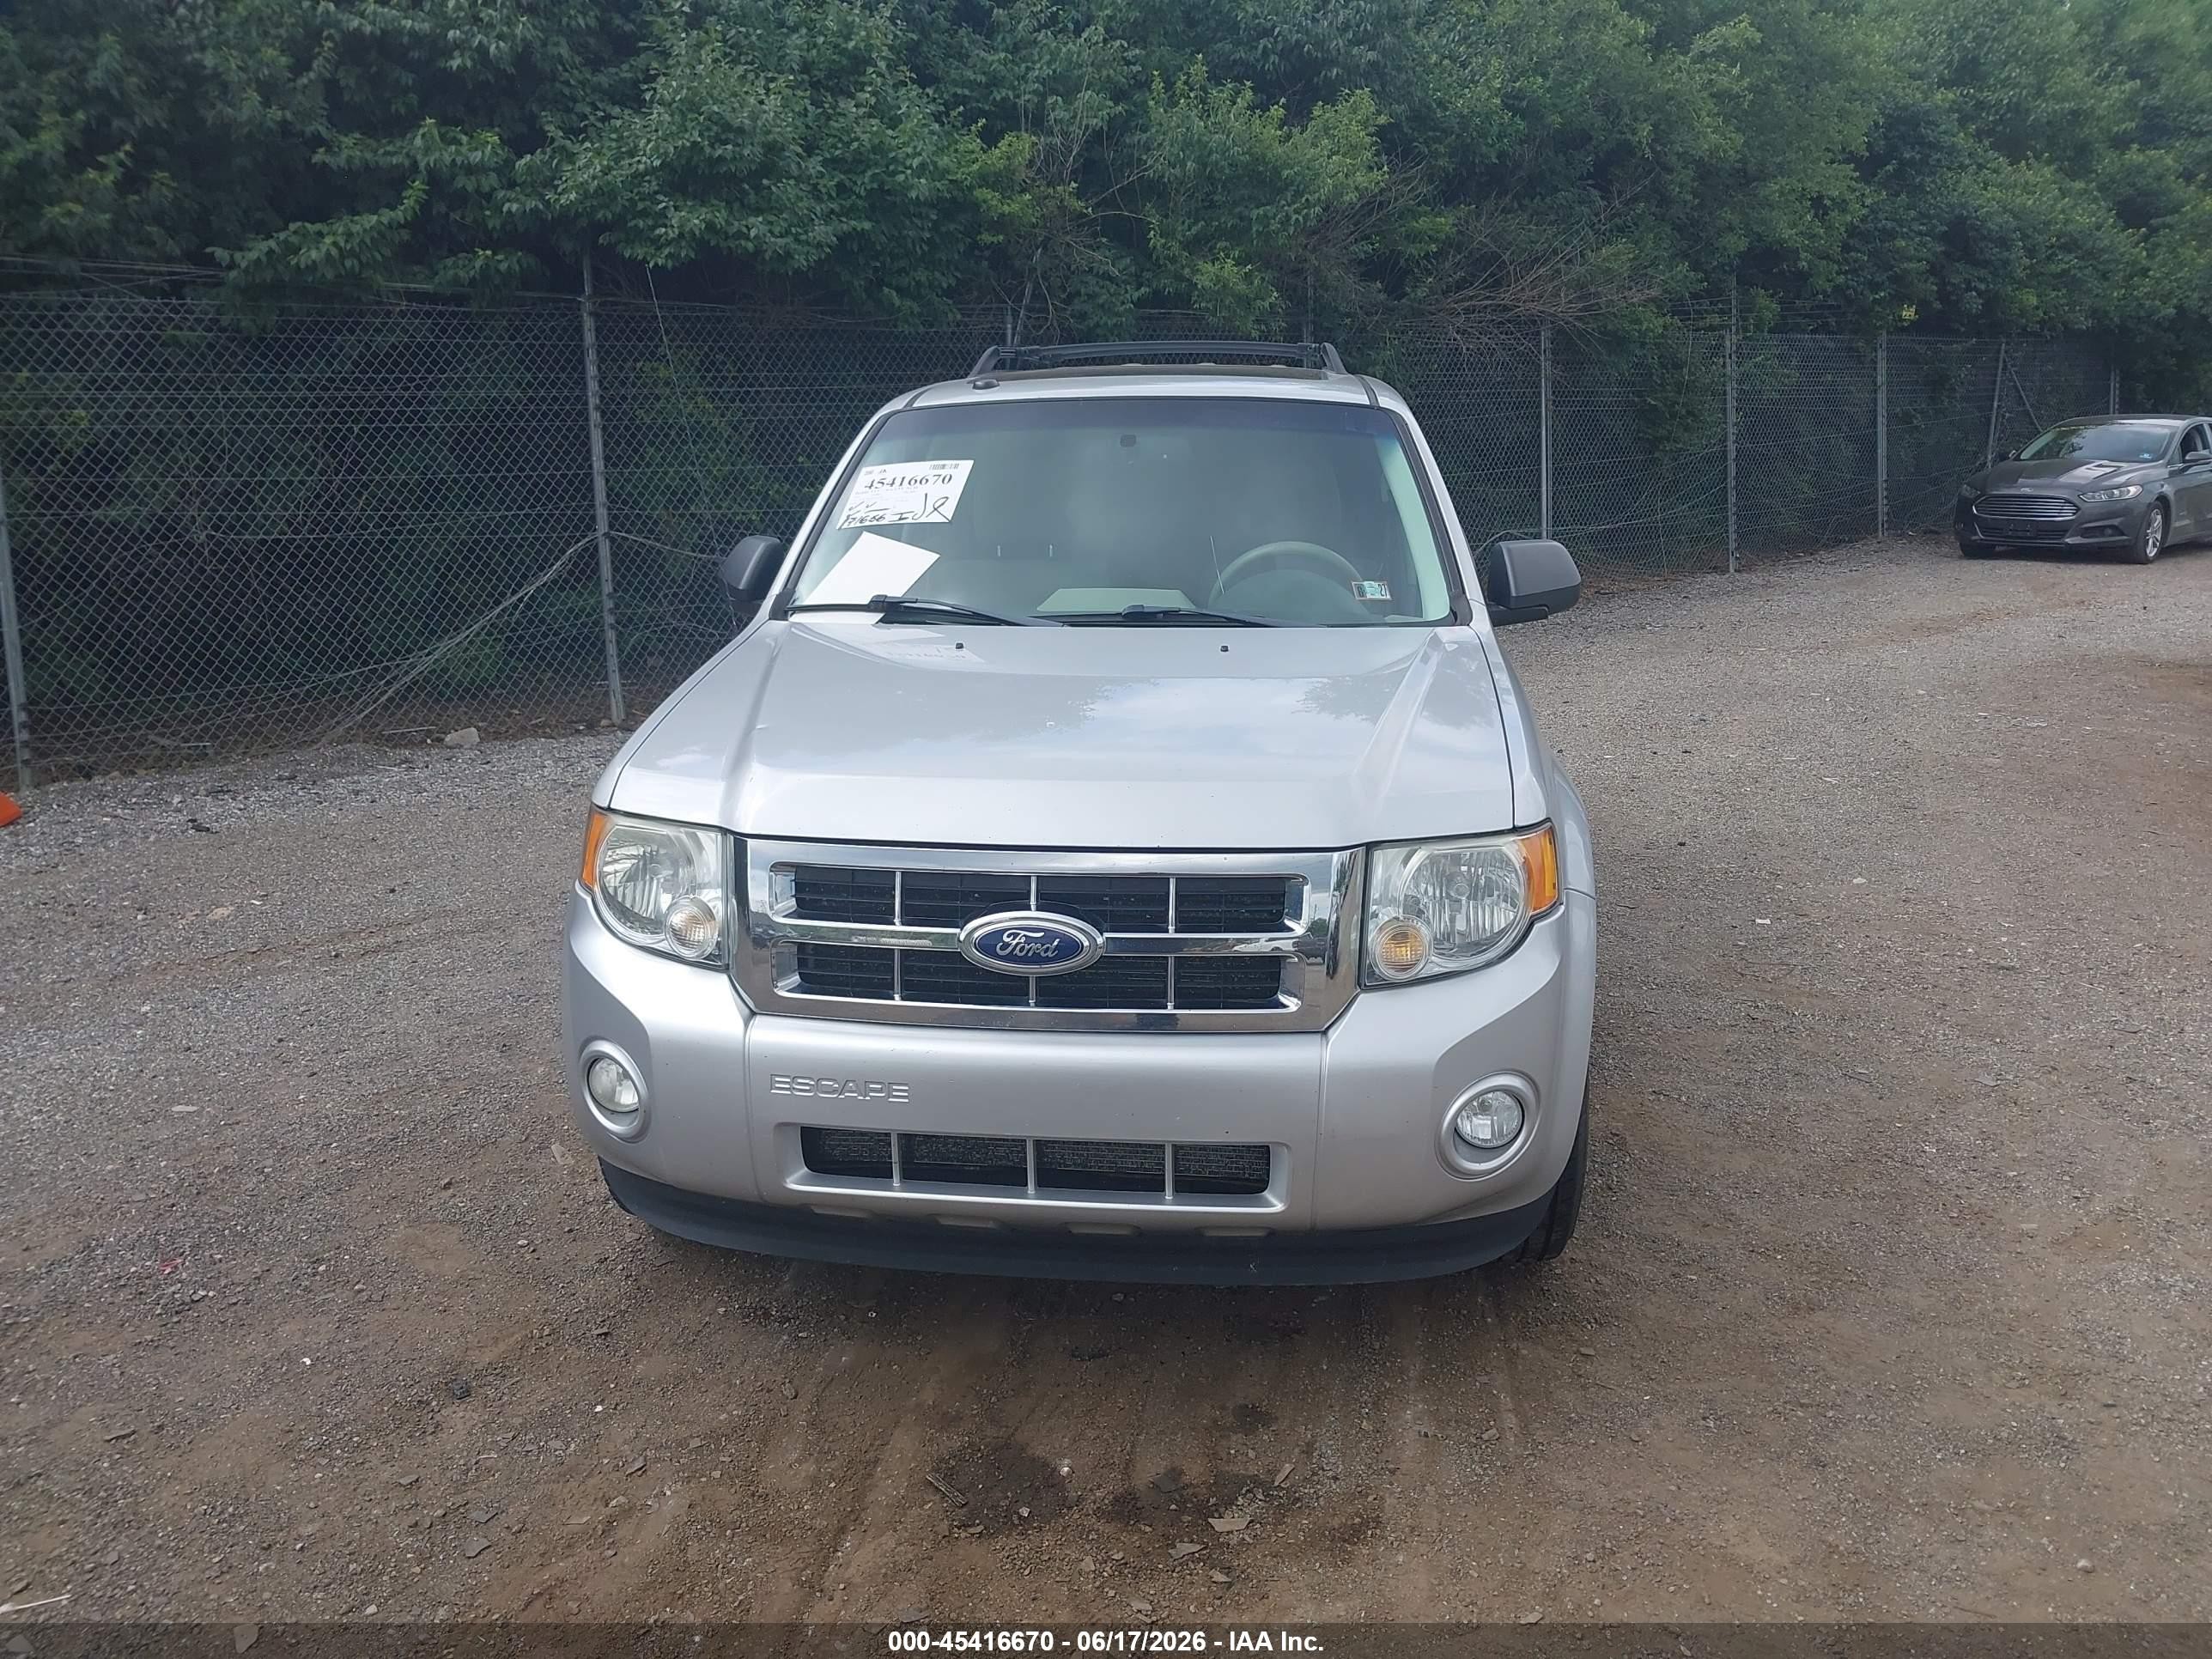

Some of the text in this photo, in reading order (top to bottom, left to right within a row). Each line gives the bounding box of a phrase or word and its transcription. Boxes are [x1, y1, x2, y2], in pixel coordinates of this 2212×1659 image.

[864, 473, 953, 490] 45416670
[995, 929, 1060, 957] Ford
[769, 1073, 910, 1103] ESCAPE
